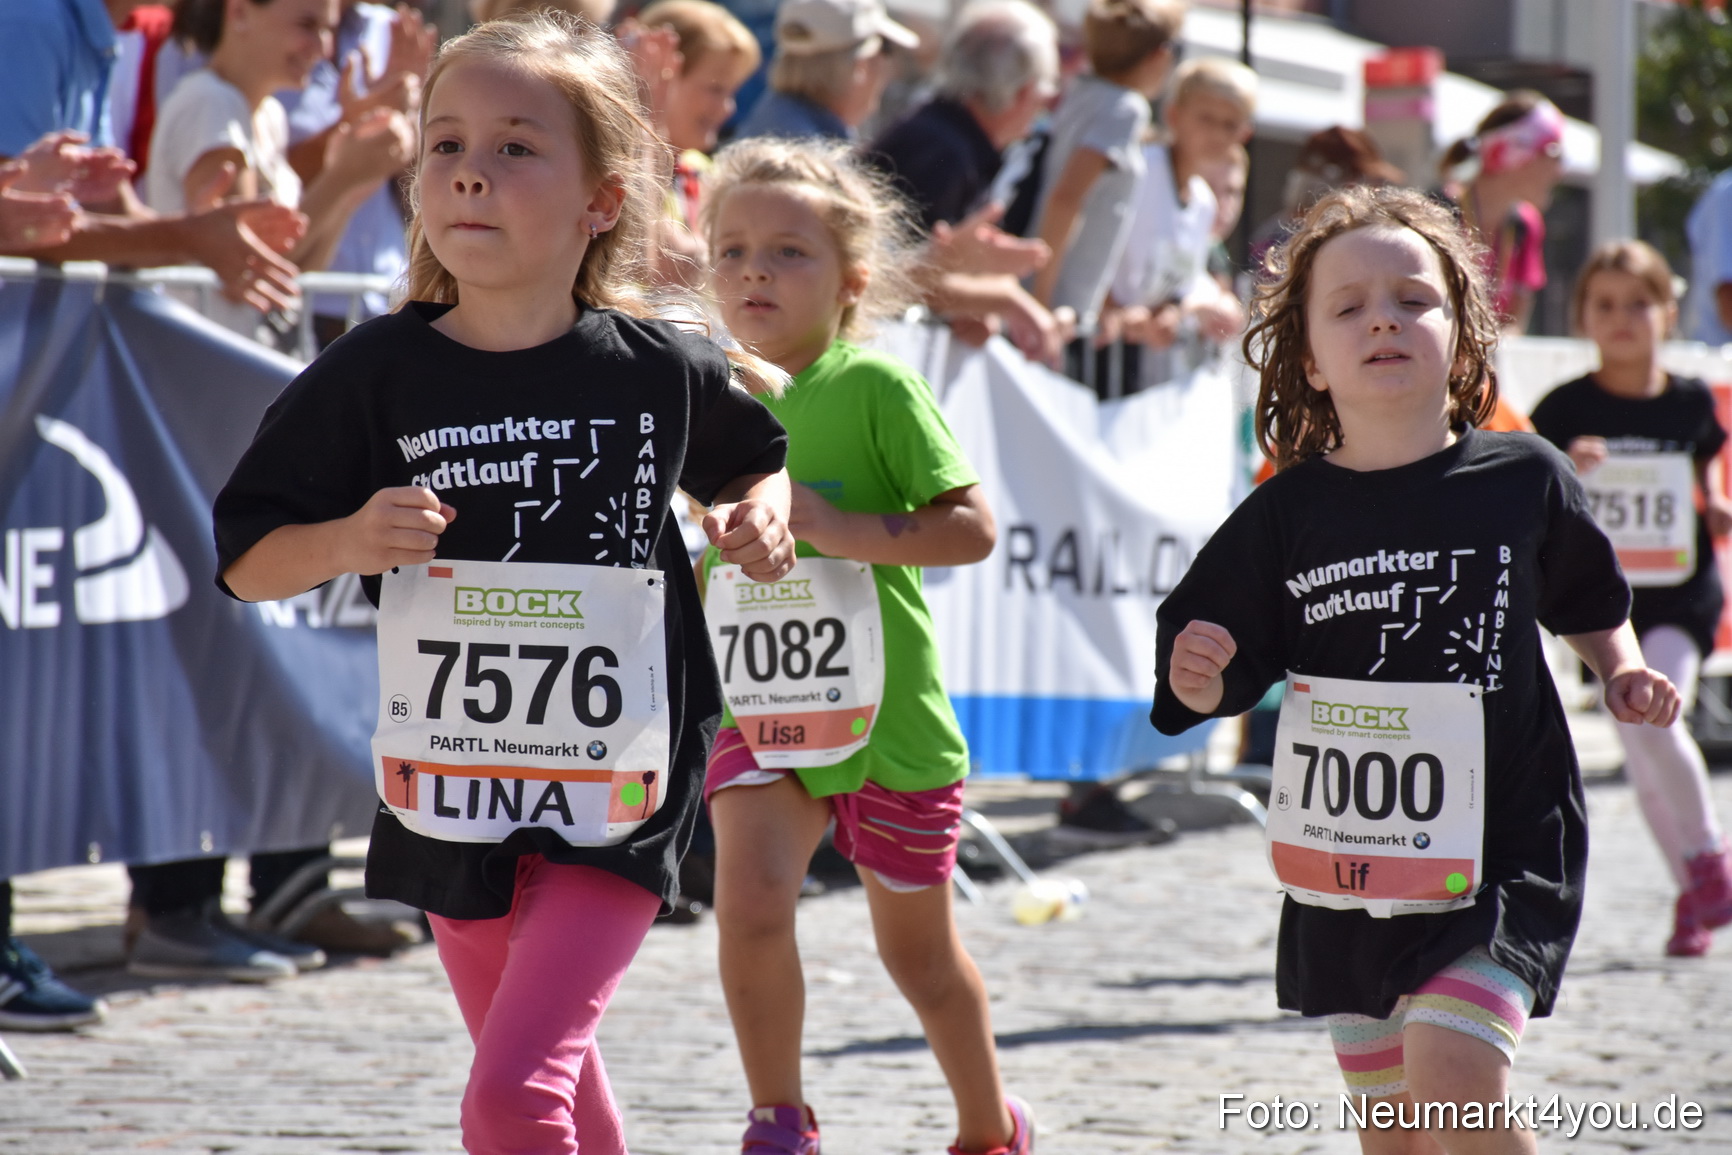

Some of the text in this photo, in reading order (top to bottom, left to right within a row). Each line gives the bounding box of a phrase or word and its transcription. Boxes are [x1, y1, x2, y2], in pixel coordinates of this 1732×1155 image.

[396, 417, 576, 463] Neumarkter
[411, 452, 539, 490] tdtlauf
[1587, 490, 1675, 529] 7518
[1285, 549, 1439, 599] Numarkter
[454, 586, 584, 619] BOCK
[735, 579, 814, 604] BOCK
[1304, 582, 1406, 625] tadtlauf
[453, 616, 585, 631] inspired by smart concepts
[1486, 545, 1512, 691] BAMBINI
[719, 617, 850, 684] 7082
[417, 639, 623, 728] 7576
[768, 690, 822, 705] Neumarkt
[391, 701, 408, 717] B5
[1312, 700, 1410, 731] BOCK
[430, 735, 489, 752] PARTL
[494, 739, 580, 757] Neumarkt
[758, 721, 806, 746] Lisa
[1311, 725, 1411, 741] inspired by smart concepts
[1292, 742, 1445, 822] 7000
[434, 775, 575, 826] LINA
[1278, 792, 1289, 806] B1
[1303, 824, 1407, 847] PARTL Neumarkt
[1335, 862, 1370, 891] Lif
